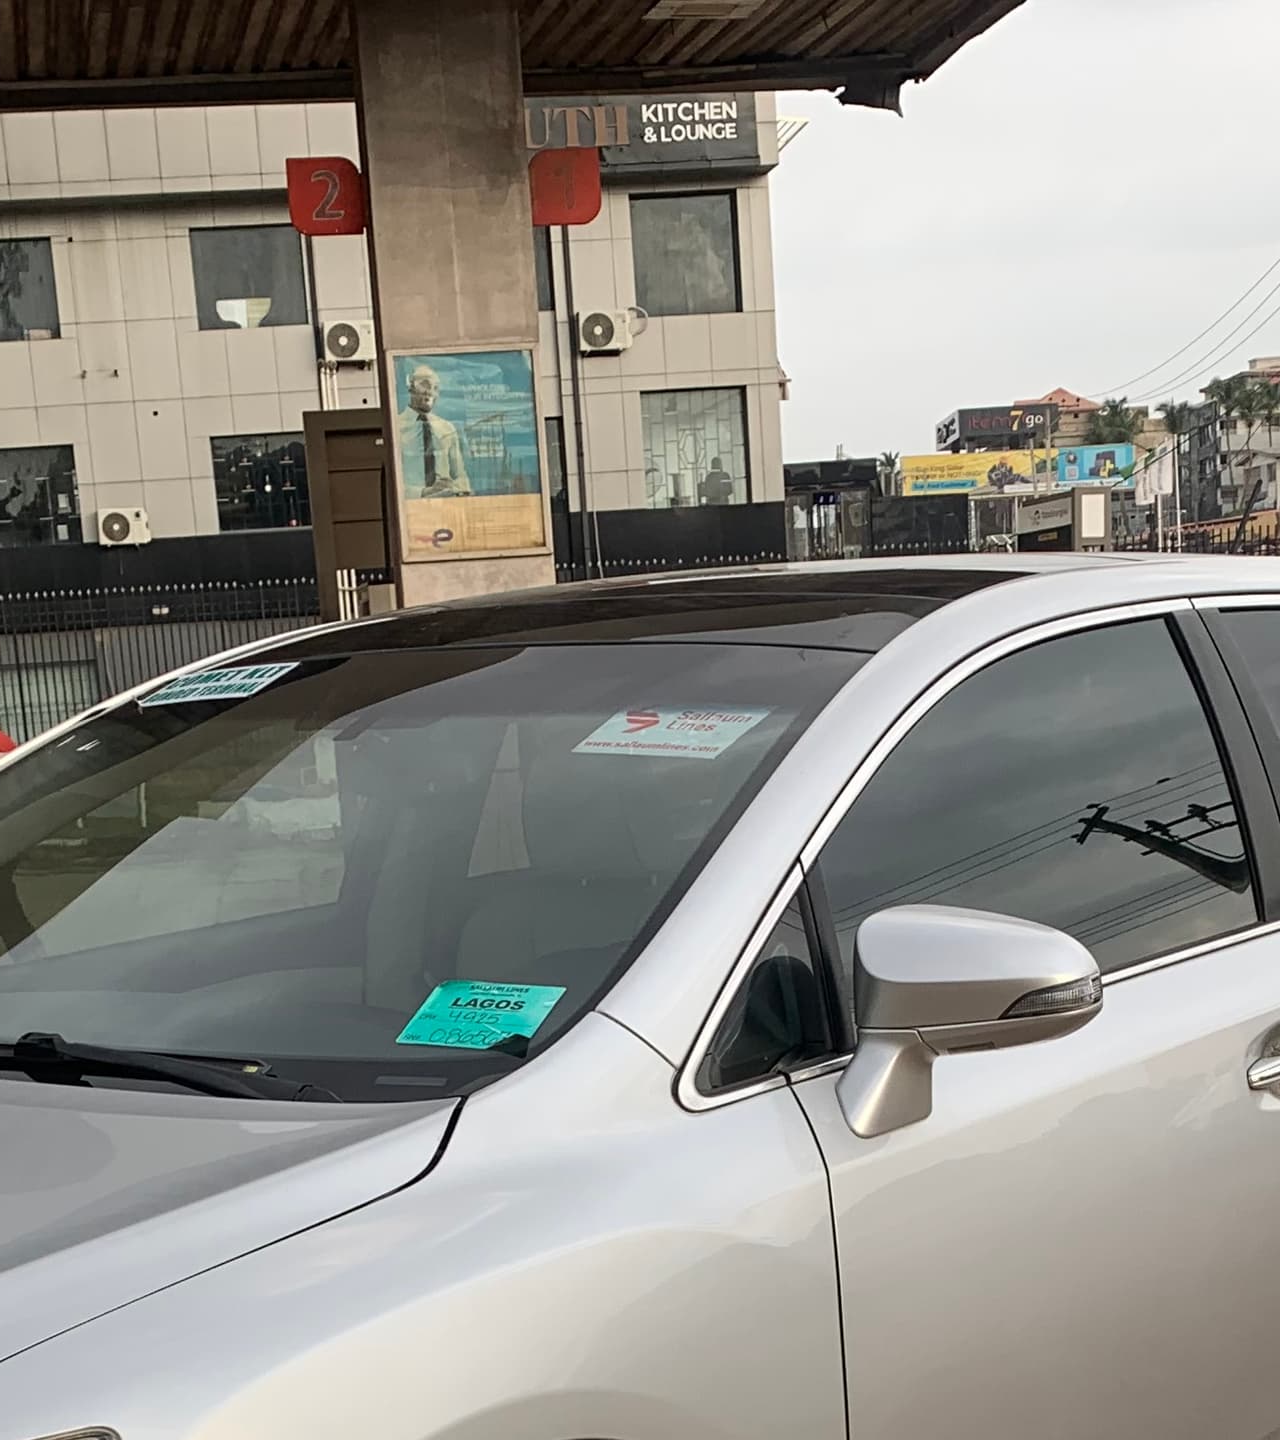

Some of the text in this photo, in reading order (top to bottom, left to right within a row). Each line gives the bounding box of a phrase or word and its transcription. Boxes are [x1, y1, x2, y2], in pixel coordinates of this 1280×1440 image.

[641, 101, 738, 123] KITCHEN
[643, 122, 738, 143] & LOUNGE
[310, 169, 345, 221] 2
[666, 720, 717, 732] Lines
[450, 997, 527, 1010] LAGOS
